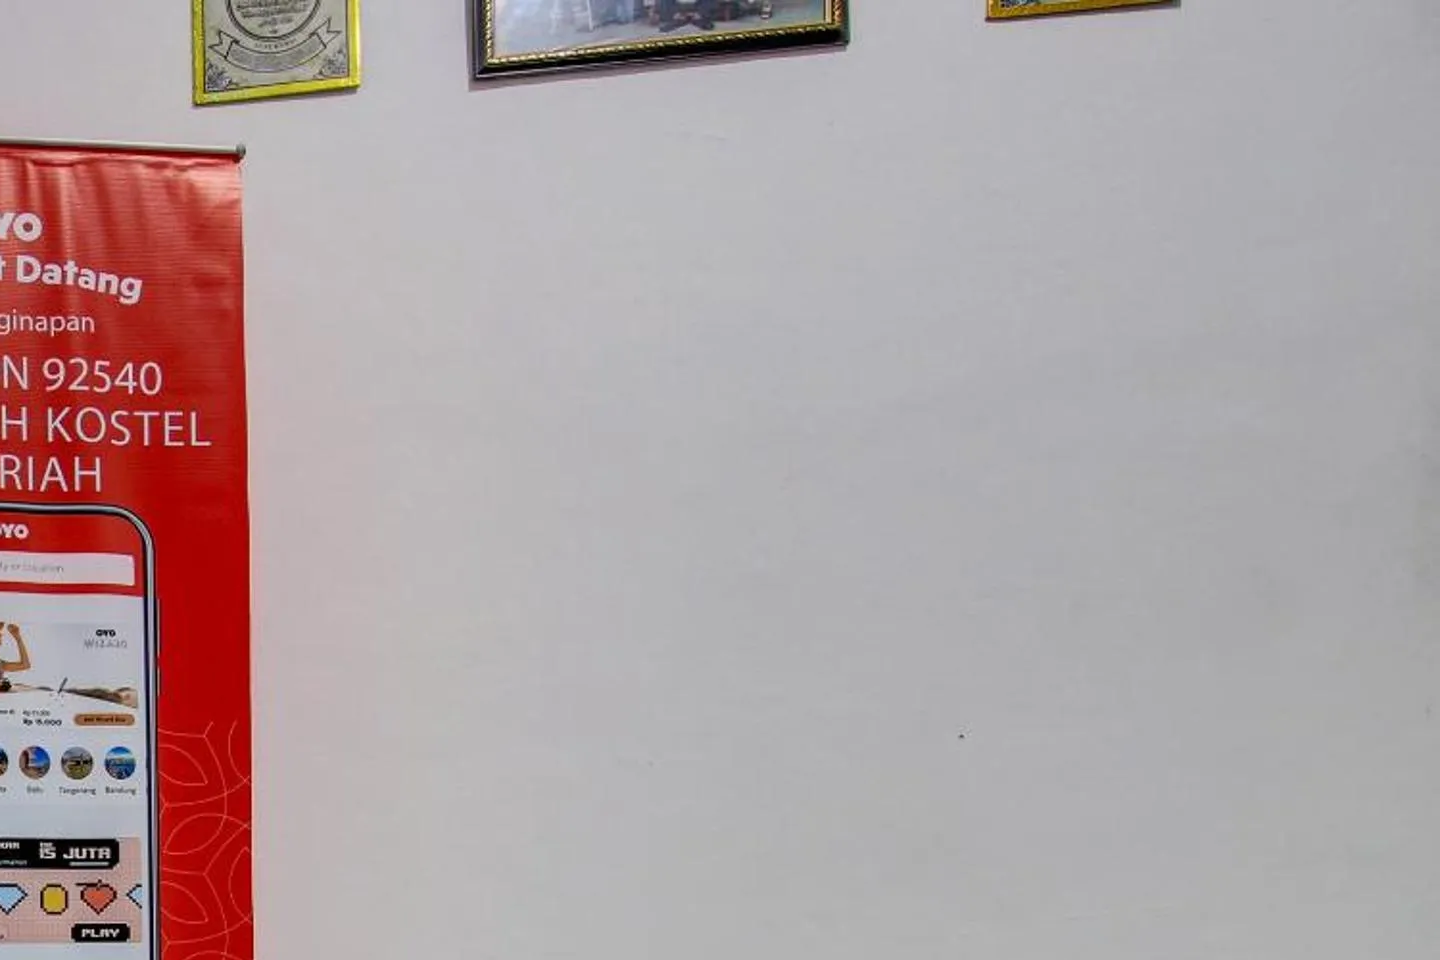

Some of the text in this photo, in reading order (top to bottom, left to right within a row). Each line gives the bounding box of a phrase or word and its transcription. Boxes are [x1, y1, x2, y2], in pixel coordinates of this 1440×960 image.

[16, 255, 142, 305] Datang
[43, 357, 162, 396] 92540
[47, 407, 211, 448] KOSTEL
[63, 847, 112, 859] JUTA
[81, 926, 120, 939] PLAY
